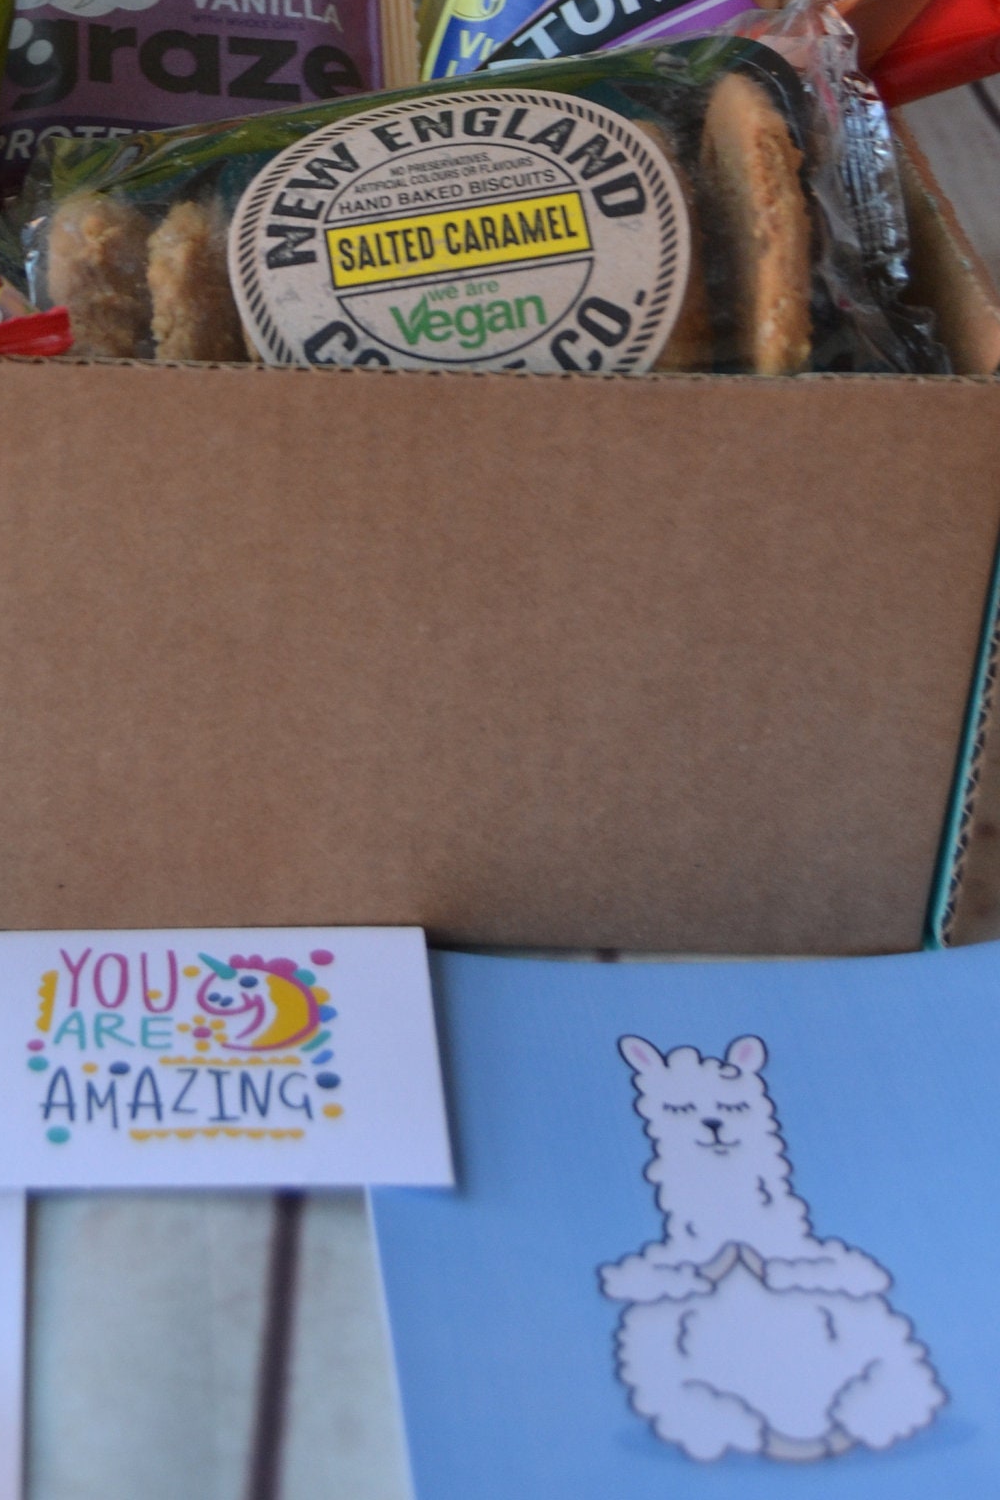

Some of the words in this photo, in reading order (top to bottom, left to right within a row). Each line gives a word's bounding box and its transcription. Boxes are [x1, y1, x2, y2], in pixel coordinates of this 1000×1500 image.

[6, 17, 364, 112] graze
[264, 140, 363, 270] NEW
[369, 105, 648, 219] ENGLAND
[338, 195, 393, 216] HAND
[399, 183, 464, 207] BAKED
[469, 168, 558, 195] BISCUITS
[354, 178, 409, 195] ARTIFICIAL
[410, 168, 460, 186] COLOURS
[461, 165, 478, 178] OR
[479, 155, 534, 174] FLAVOURS
[389, 164, 406, 177] NO
[335, 223, 435, 273] SALTED
[443, 203, 580, 258] CARAMEL
[426, 283, 460, 302] we
[465, 278, 500, 297] are
[388, 291, 548, 350] Vegan
[58, 946, 179, 1014] YOU
[52, 1010, 175, 1052] ARE
[40, 1065, 314, 1131] AMAZING
